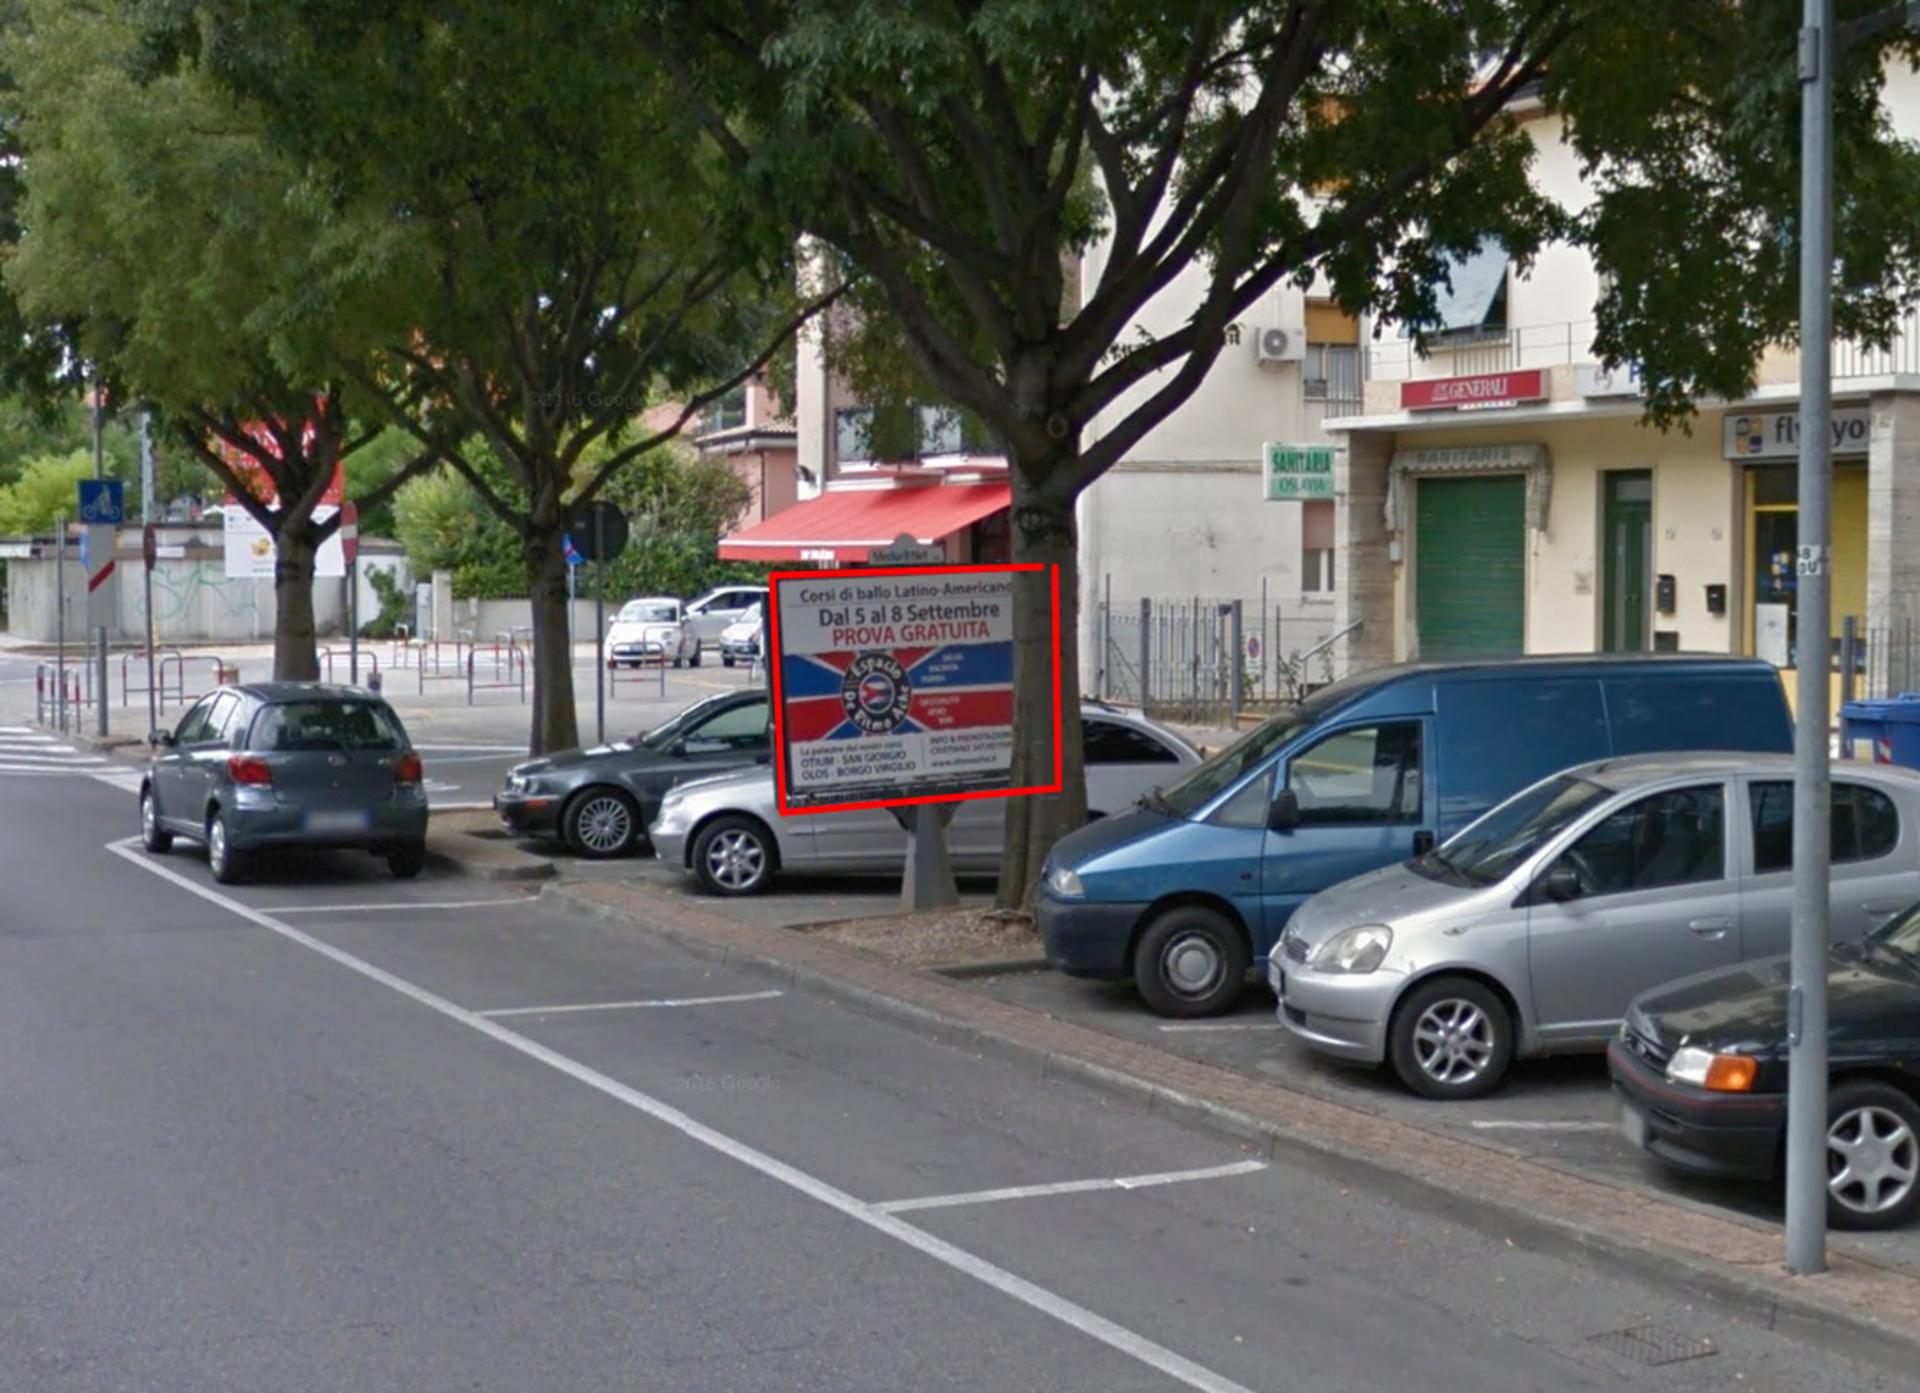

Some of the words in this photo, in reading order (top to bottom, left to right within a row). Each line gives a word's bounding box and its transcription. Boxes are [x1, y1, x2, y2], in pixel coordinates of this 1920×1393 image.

[1449, 378, 1508, 399] GENERALI
[1273, 452, 1331, 473] SANITARIA
[1417, 447, 1512, 463] SANITARIA
[800, 588, 836, 603] Corsi
[839, 587, 853, 601] di
[857, 585, 891, 600] ballo
[894, 581, 1014, 598] Latino-Americano
[819, 606, 850, 627] Dal
[855, 607, 867, 625] 5
[871, 605, 887, 624] al
[891, 604, 902, 622] 8
[907, 600, 1000, 622] Settembre
[832, 626, 896, 646] PROVA
[901, 620, 990, 642] GRATUITA
[851, 658, 902, 680] Espacio
[800, 757, 834, 769] OTIUM
[842, 753, 862, 765] SAN
[863, 750, 907, 763] GIORGIO
[801, 769, 829, 781] OLOS
